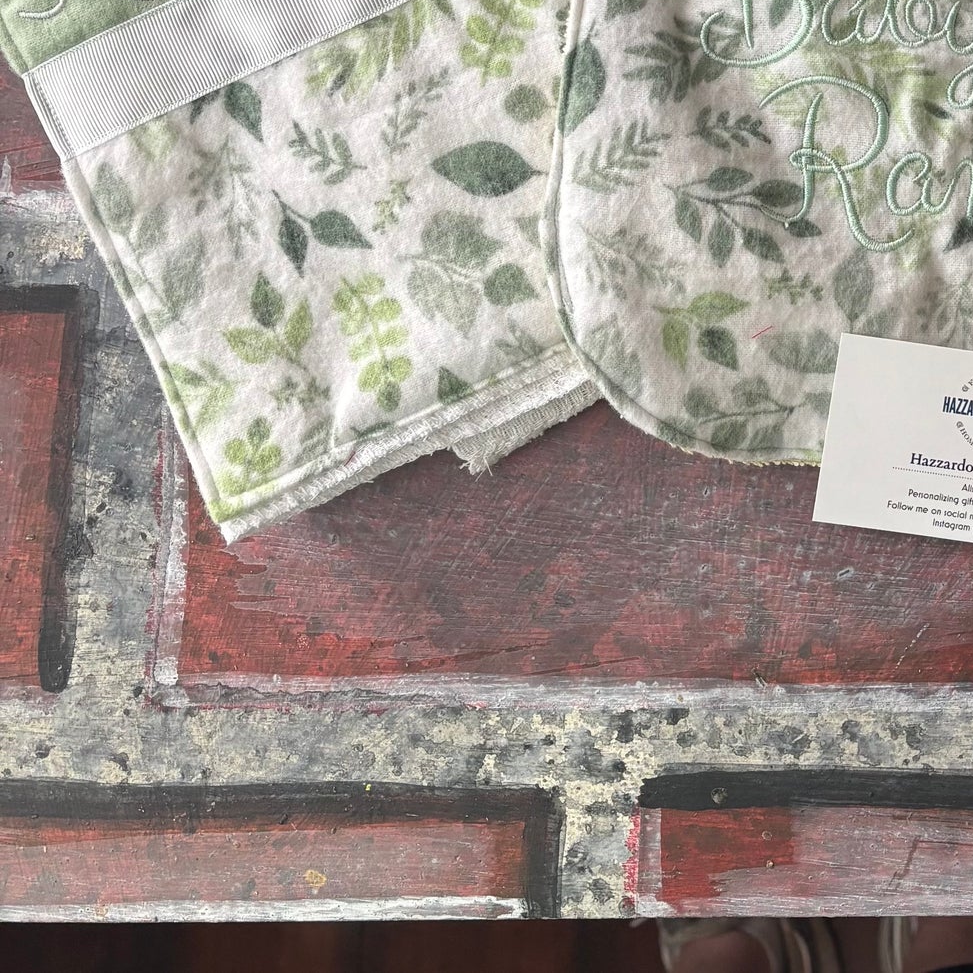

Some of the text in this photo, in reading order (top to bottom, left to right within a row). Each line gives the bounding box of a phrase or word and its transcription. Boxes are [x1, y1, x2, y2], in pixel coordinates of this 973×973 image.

[908, 488, 959, 505] Personalizing
[887, 500, 914, 511] Follow
[915, 506, 929, 514] me
[931, 508, 942, 516] on
[944, 509, 967, 520] social
[932, 518, 971, 531] Instagram
